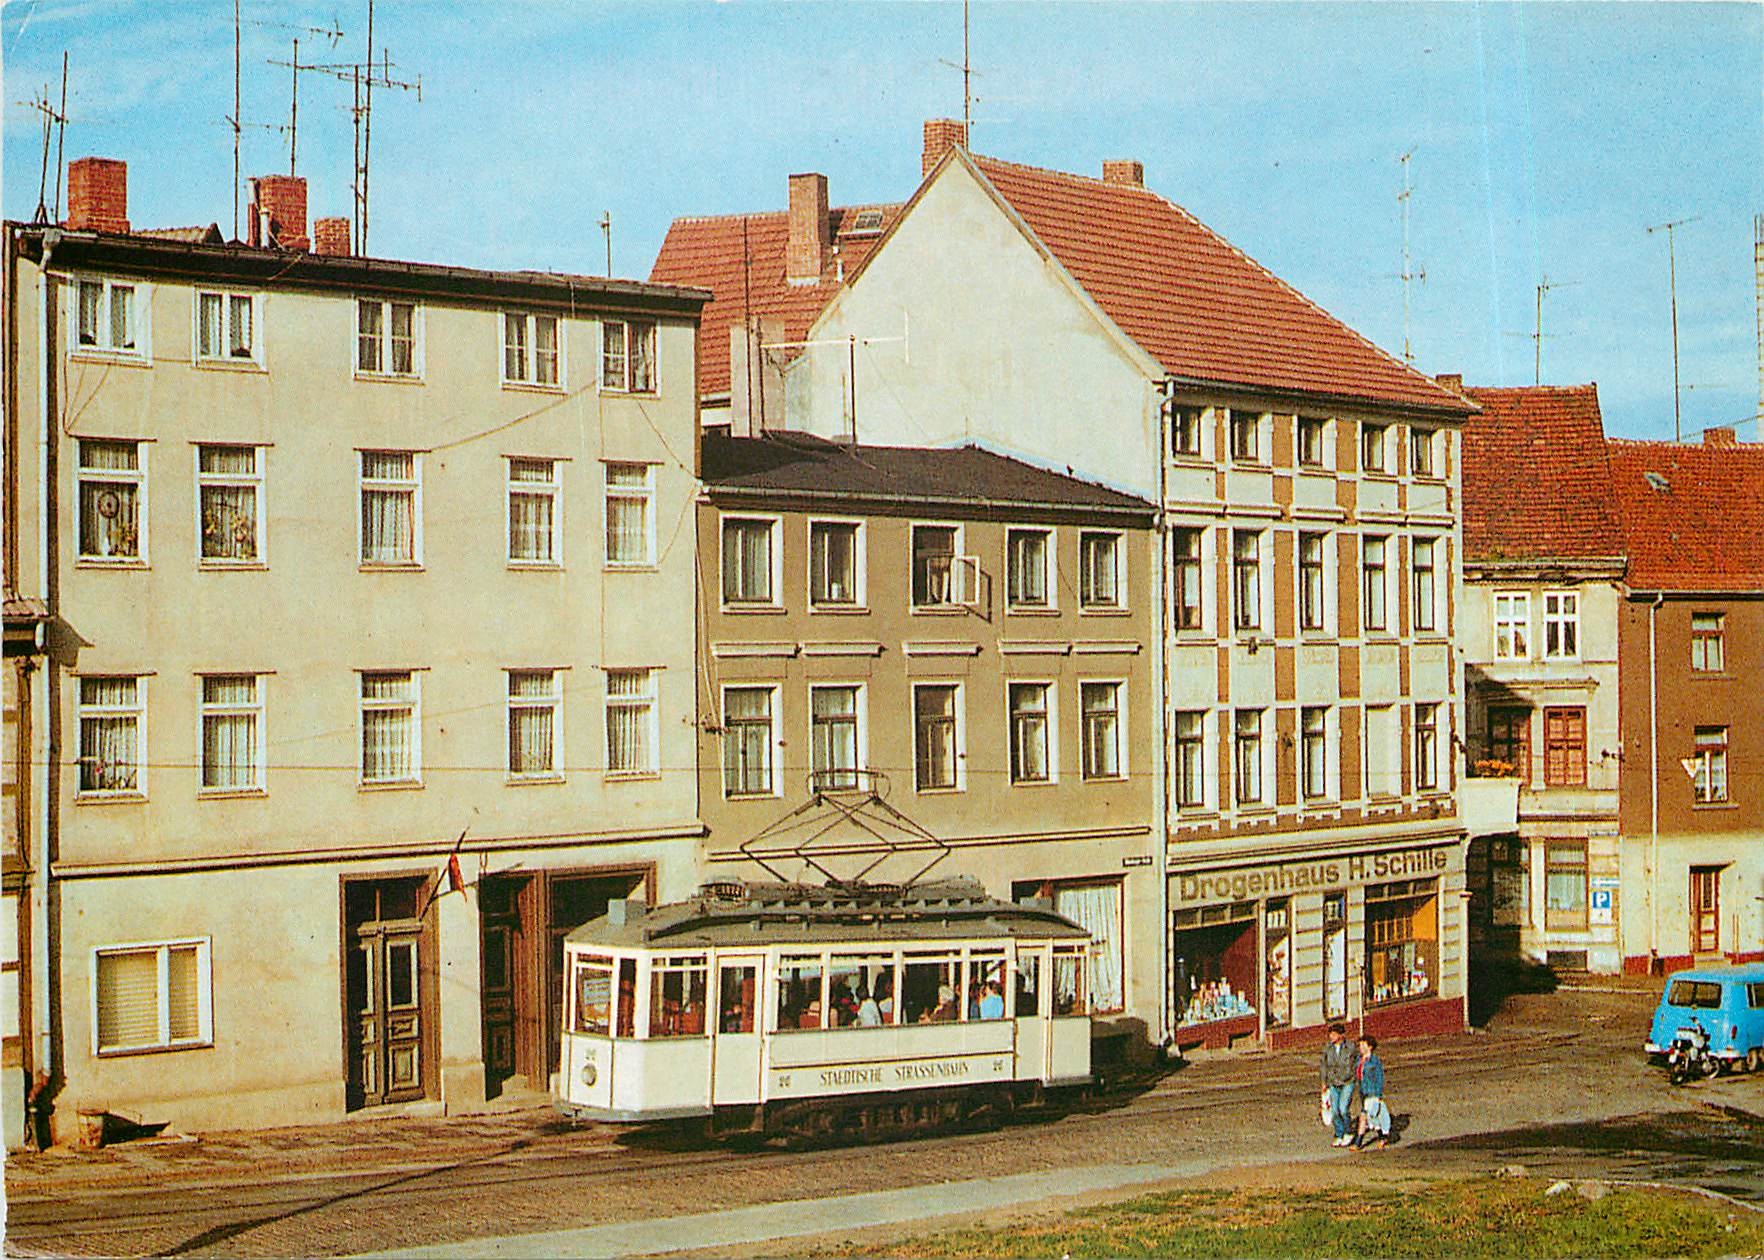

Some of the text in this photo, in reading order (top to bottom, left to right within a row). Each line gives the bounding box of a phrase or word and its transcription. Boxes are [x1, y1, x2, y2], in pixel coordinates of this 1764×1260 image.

[1180, 862, 1340, 901] Drogenhaus
[1596, 892, 1608, 908] P
[820, 1067, 882, 1088] STAEDTISCHE
[895, 1061, 969, 1082] STRASSENBAHN
